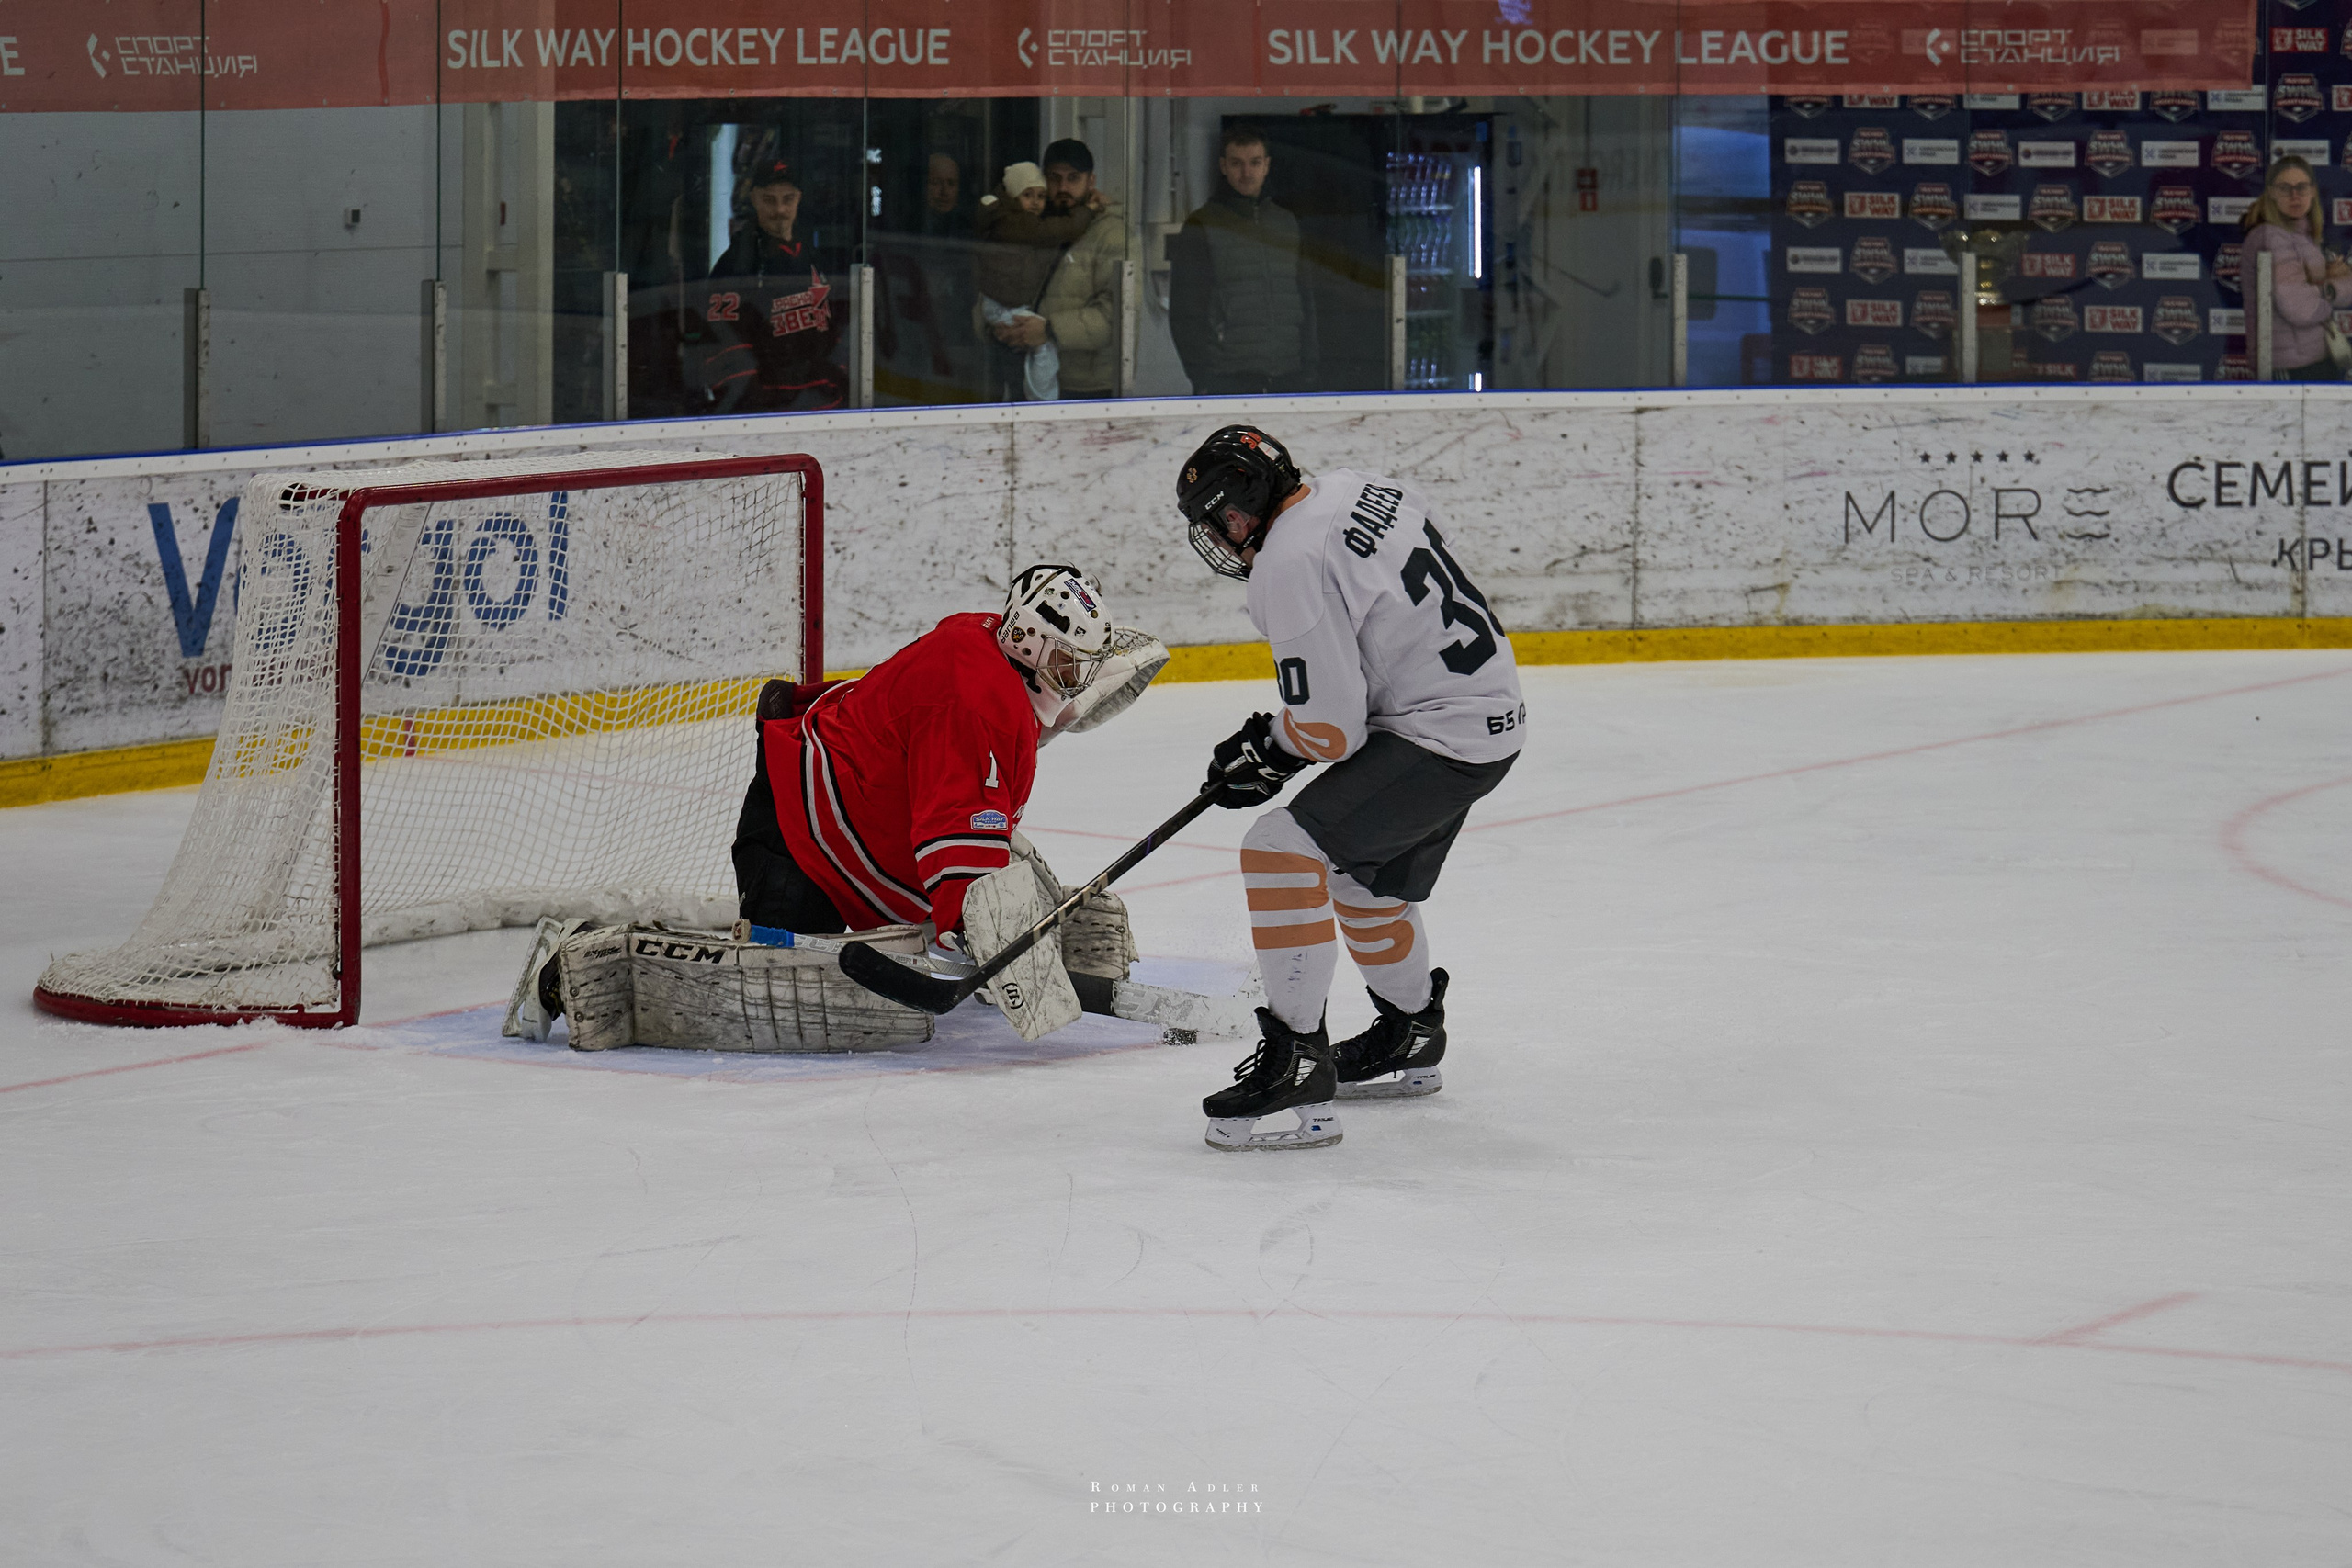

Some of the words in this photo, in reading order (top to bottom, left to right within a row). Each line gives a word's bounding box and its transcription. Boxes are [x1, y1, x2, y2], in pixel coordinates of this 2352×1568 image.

[1047, 29, 1147, 47] СПОРТ
[1961, 29, 2073, 46] СПОРТ
[2295, 28, 2324, 39] SILK
[115, 36, 209, 54] СПОРТ
[447, 29, 524, 69] SILK
[534, 28, 616, 67] WAY
[627, 28, 785, 67] HOCKEY
[797, 28, 950, 66] LEAGUE
[1267, 28, 1359, 65] SILK
[1370, 29, 1468, 65] WAY
[1482, 28, 1662, 65] HOCKEY
[1674, 29, 1849, 65] LEAGUE
[2296, 40, 2324, 51] WAY
[1048, 49, 1192, 69] СТАНЦИЯ
[1961, 47, 2120, 65] СТАНЦИЯ
[121, 55, 257, 78] СТАНЦИЯ
[707, 292, 741, 321] 22
[1204, 491, 1225, 510] CCM
[1342, 483, 1404, 558] ФАДЕЕВ
[1890, 567, 1934, 584] SPA
[1969, 564, 2062, 583] RESORT
[1274, 656, 1310, 705] 0
[985, 750, 1000, 789] 1
[635, 939, 727, 964] CCM
